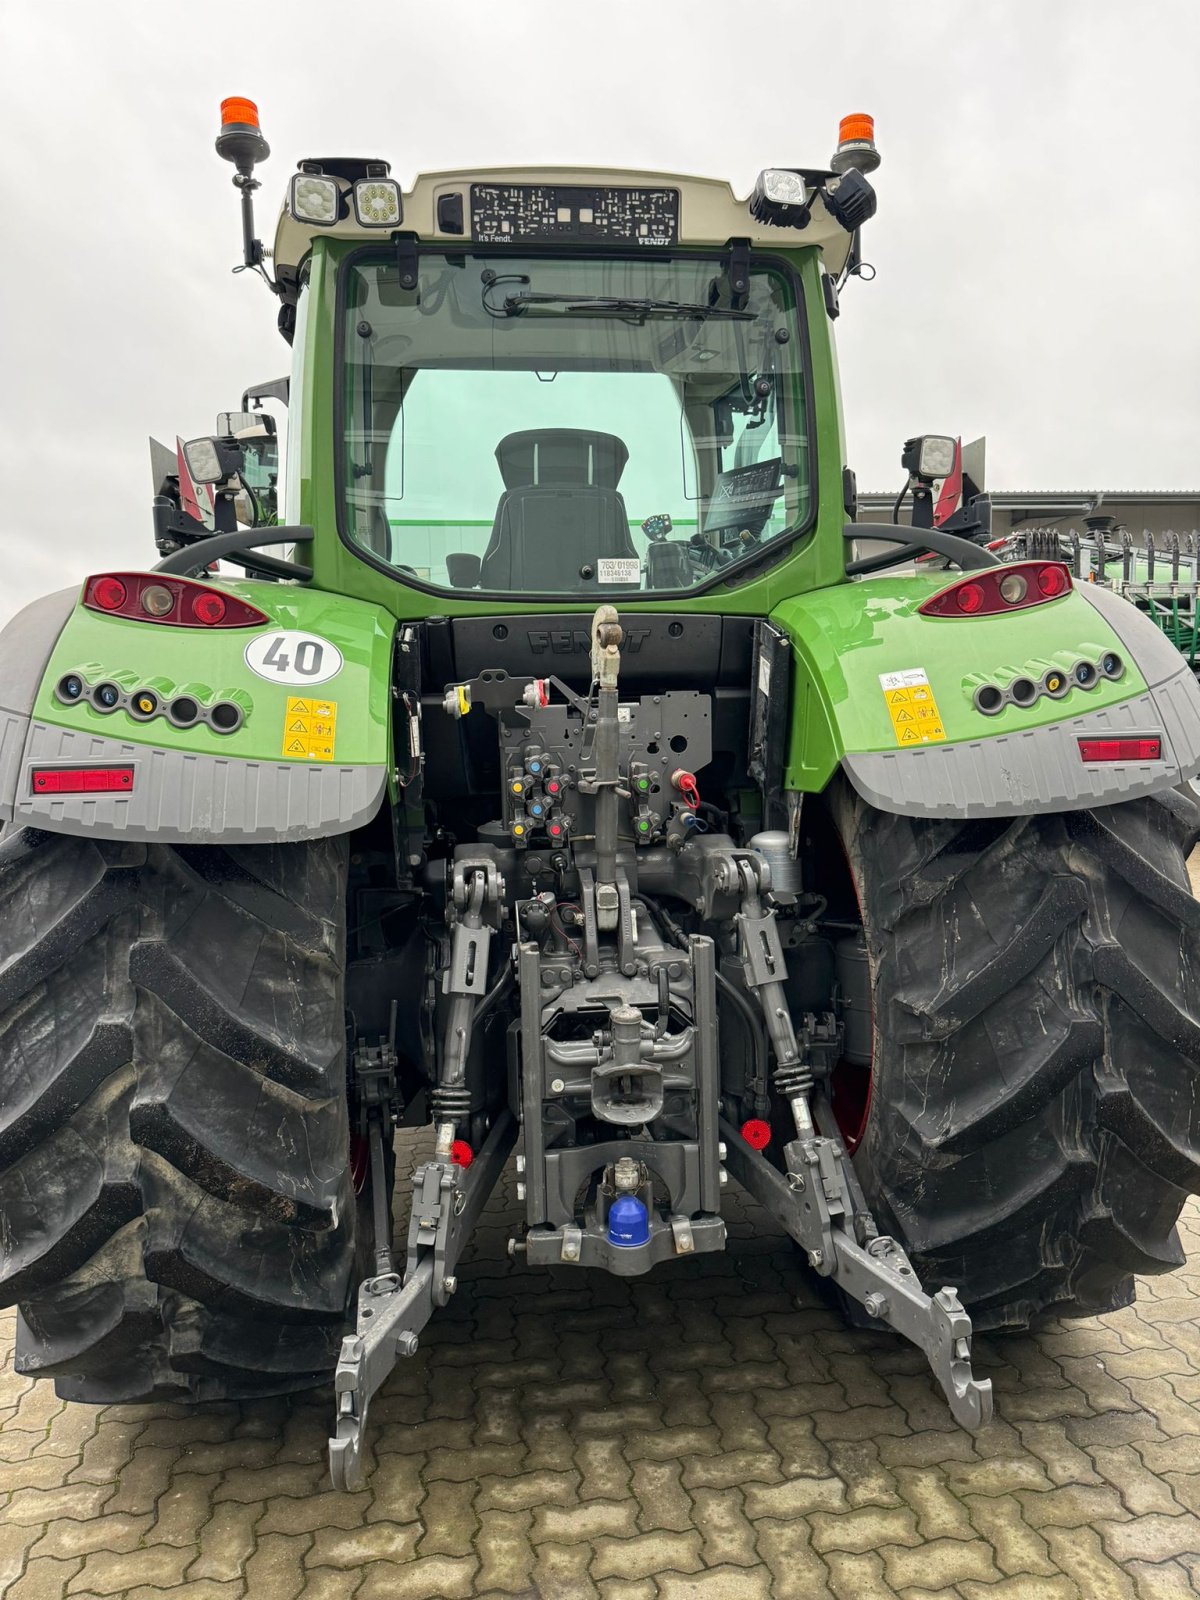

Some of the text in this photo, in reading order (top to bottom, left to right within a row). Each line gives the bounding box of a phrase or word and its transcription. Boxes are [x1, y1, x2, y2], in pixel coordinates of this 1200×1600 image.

[478, 234, 513, 243] It's Fendt.
[638, 237, 671, 245] FENDT
[527, 629, 652, 654] FENT
[262, 637, 324, 676] 40
